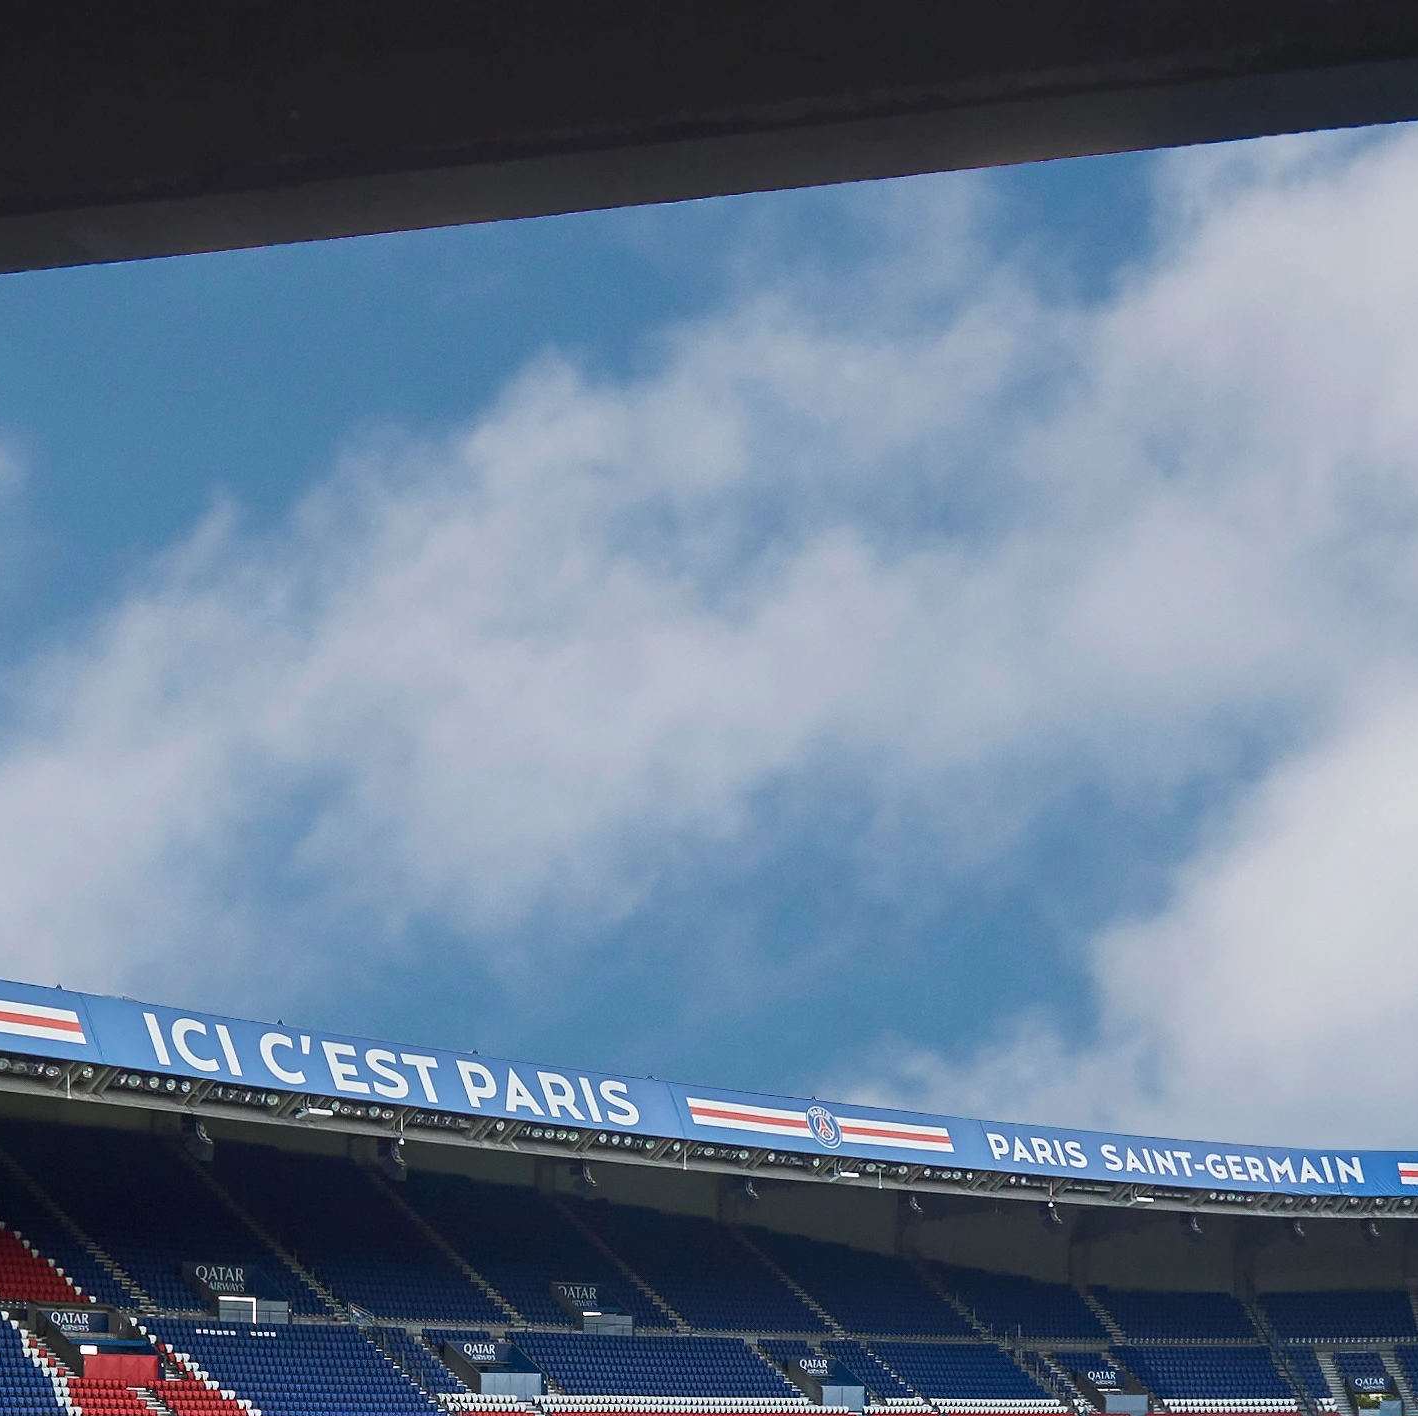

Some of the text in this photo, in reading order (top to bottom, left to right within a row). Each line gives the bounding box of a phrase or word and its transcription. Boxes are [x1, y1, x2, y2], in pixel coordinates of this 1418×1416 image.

[142, 1012, 640, 1126] ICI C'EST PARIS
[986, 1132, 1365, 1184] PARIS SAINT-GERMAIN
[195, 1265, 244, 1283] QATAR
[208, 1281, 245, 1292] AIRWAYS
[51, 1312, 89, 1325] QATAR
[463, 1343, 496, 1355] QATAR
[799, 1359, 828, 1370] QATAR
[1087, 1371, 1116, 1381] QATAR
[1355, 1377, 1385, 1386] QATAR
